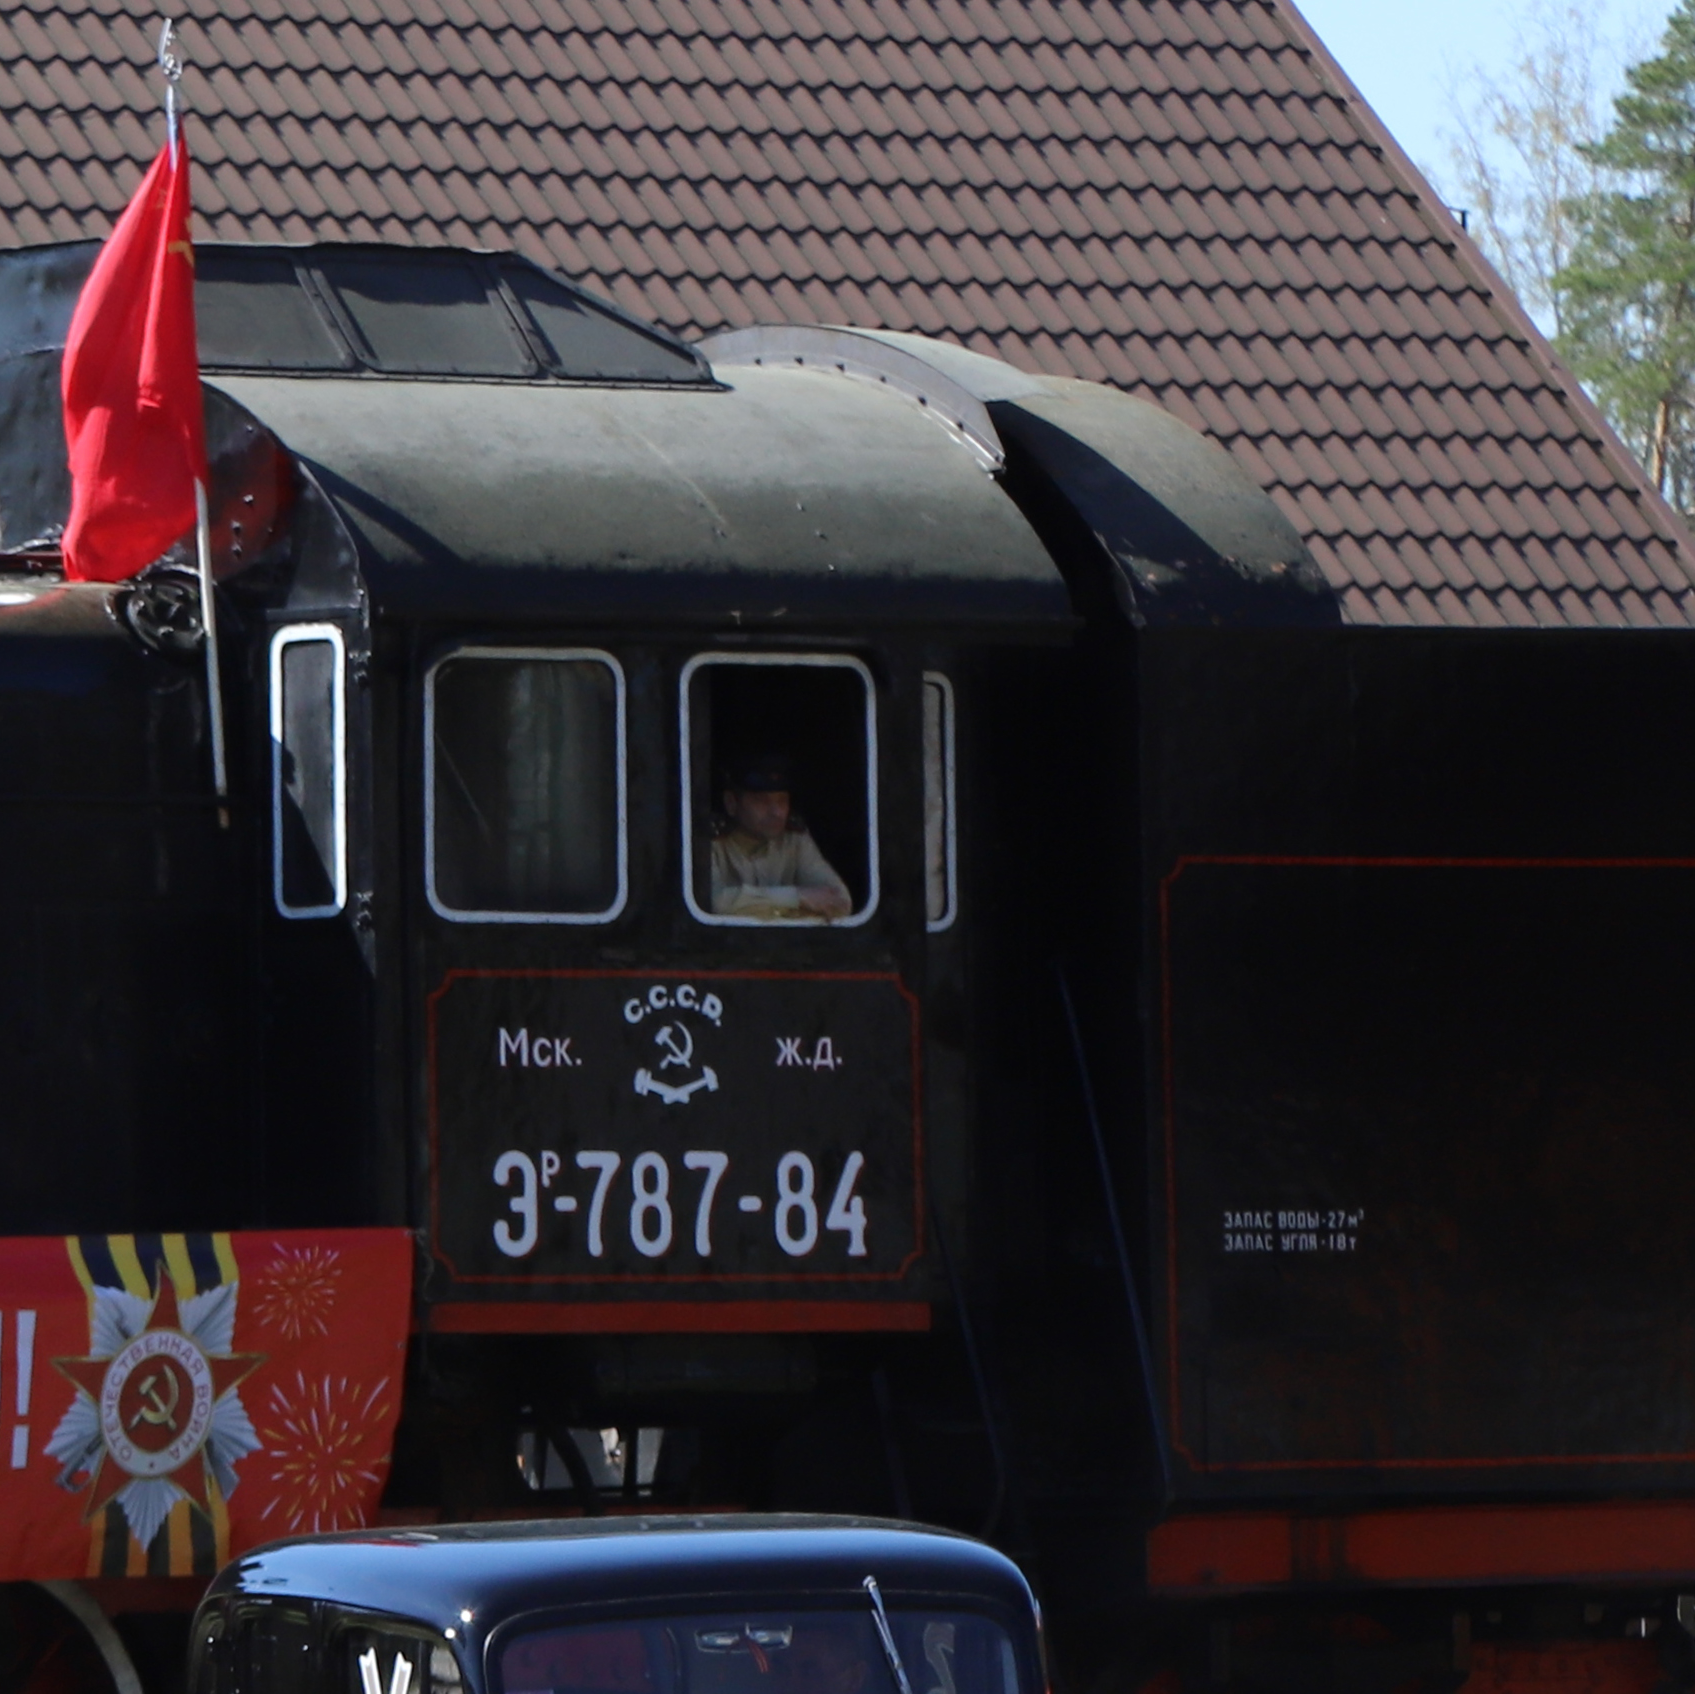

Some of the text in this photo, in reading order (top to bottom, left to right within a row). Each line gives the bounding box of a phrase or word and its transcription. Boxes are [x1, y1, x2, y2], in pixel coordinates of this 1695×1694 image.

[498, 1027, 583, 1067] Мск.
[1224, 1210, 1273, 1229] ЗАПАС
[1224, 1233, 1274, 1252] ЗАПАС
[105, 1335, 205, 1461] ОТЕЧЕСТВЕННАЯ
